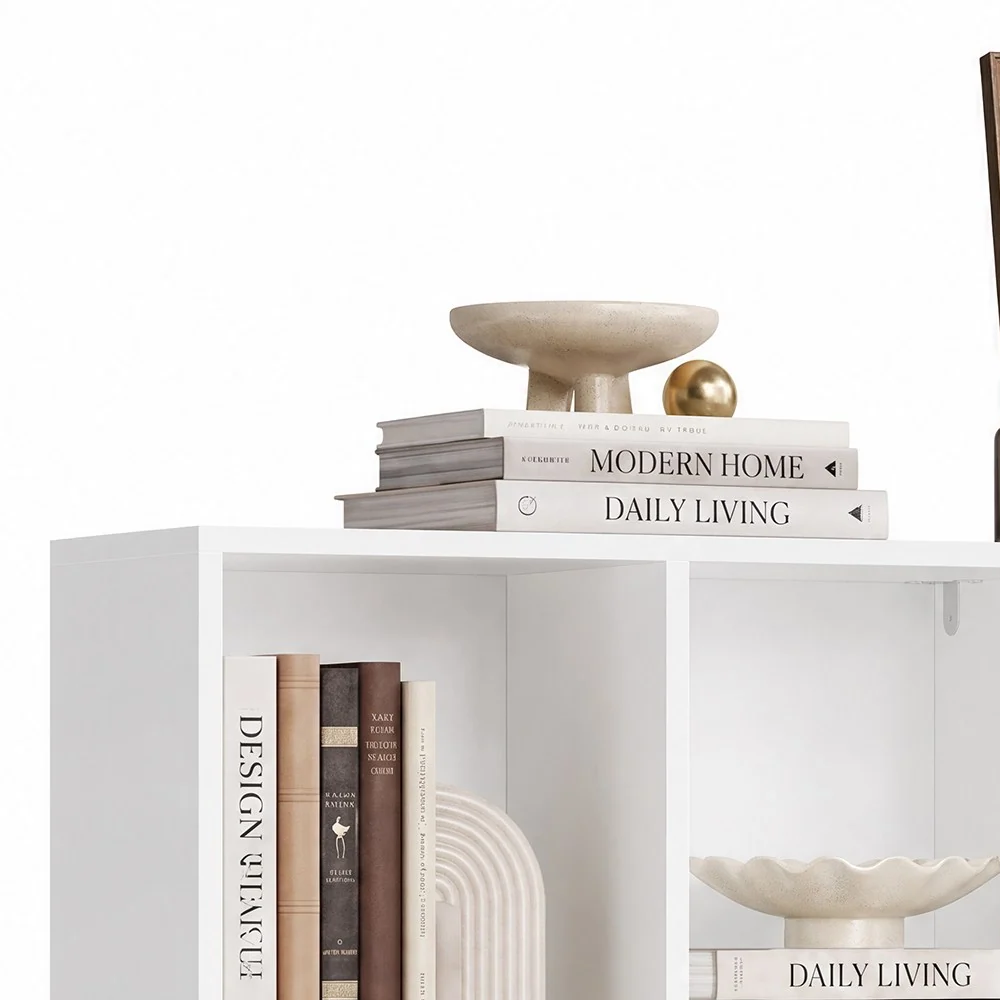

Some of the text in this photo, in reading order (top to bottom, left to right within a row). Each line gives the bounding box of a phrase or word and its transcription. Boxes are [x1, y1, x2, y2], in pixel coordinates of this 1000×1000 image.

[590, 448, 713, 477] MODERN
[721, 453, 805, 480] HOME
[605, 496, 790, 526] DAILY LIVING
[239, 715, 264, 840] DESIGN
[789, 962, 971, 988] DAILY LIVING
